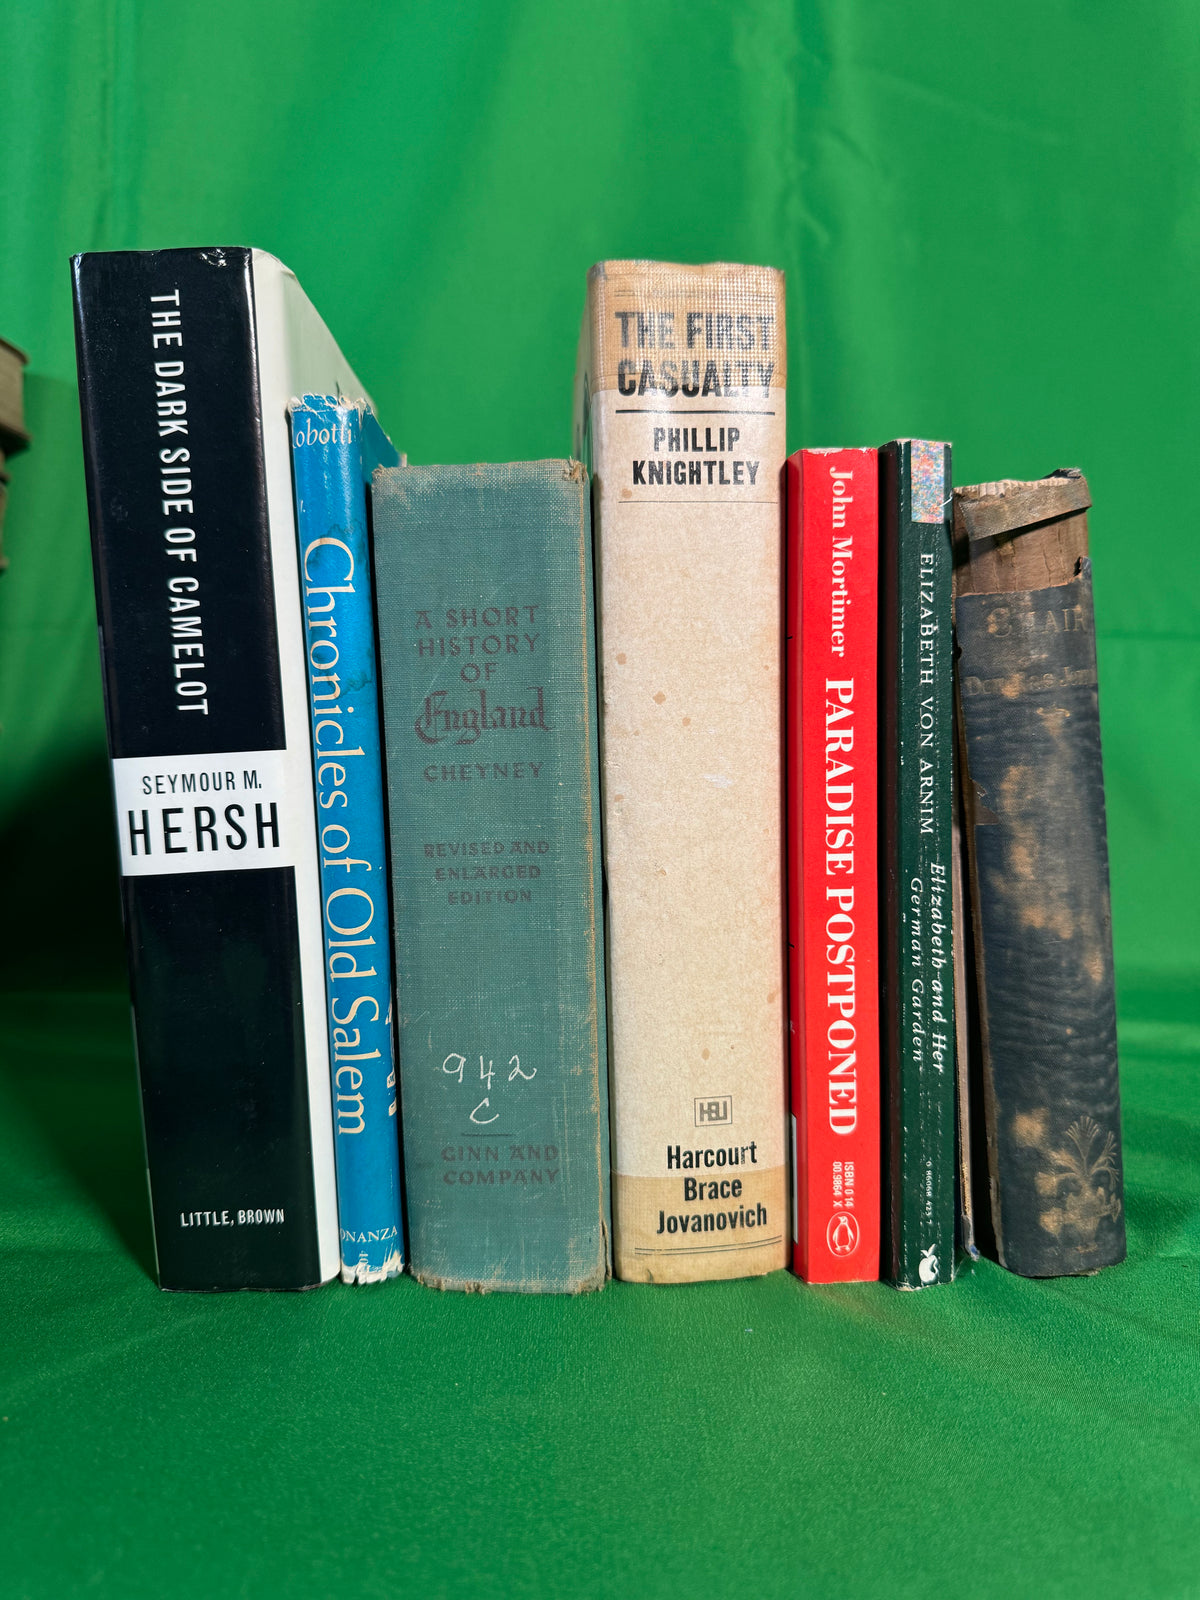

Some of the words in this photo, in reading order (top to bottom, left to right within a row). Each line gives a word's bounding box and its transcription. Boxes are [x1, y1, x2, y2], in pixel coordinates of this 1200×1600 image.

[150, 289, 182, 348] THE
[615, 311, 675, 349] THE
[686, 312, 775, 351] FIRST
[153, 360, 187, 437] DARK
[617, 358, 775, 399] CASUALTY
[653, 427, 740, 453] PHILLIP
[159, 448, 193, 516] SIDE
[632, 460, 760, 486] KNIGHTLEY
[829, 466, 854, 530] John
[163, 527, 197, 564] OF
[414, 610, 432, 629] A
[446, 605, 540, 629] SHORT
[830, 536, 854, 658] Mortimer
[919, 553, 934, 685] ELIZABETH
[167, 576, 209, 715] CAMELOT
[418, 633, 540, 657] HISTORY
[304, 537, 366, 809] Chronicles
[460, 662, 498, 683] OF
[414, 686, 551, 745] England
[920, 697, 934, 748] VON
[142, 771, 237, 795] SEYMOUR
[243, 769, 263, 790] M.
[423, 762, 543, 783] CHEYNEY
[825, 677, 855, 876] PARADISE
[919, 760, 934, 835] ARNIM
[127, 801, 281, 857] HERSH
[320, 824, 371, 873] of
[424, 842, 505, 858] REVISED
[510, 841, 550, 855] AND
[435, 865, 542, 881] ENLARGED
[448, 890, 532, 905] EDITION
[930, 862, 948, 969] Elizabeth
[325, 888, 377, 983] Old
[911, 877, 924, 968] German
[825, 885, 858, 1136] POSTPONED
[912, 978, 926, 1062] Garden
[931, 979, 948, 1023] and
[331, 995, 382, 1136] Salem
[932, 1032, 948, 1074] Her
[441, 1145, 500, 1162] GINN
[509, 1144, 560, 1161] AND
[667, 1141, 758, 1170] Harcourt
[844, 1161, 854, 1187] ISBN
[443, 1168, 561, 1186] COMPANY
[684, 1177, 743, 1202] Brace
[180, 1209, 235, 1228] LITTLE,
[237, 1208, 285, 1226] BROWN
[656, 1202, 768, 1235] Jovanovich
[844, 1196, 854, 1207] 14
